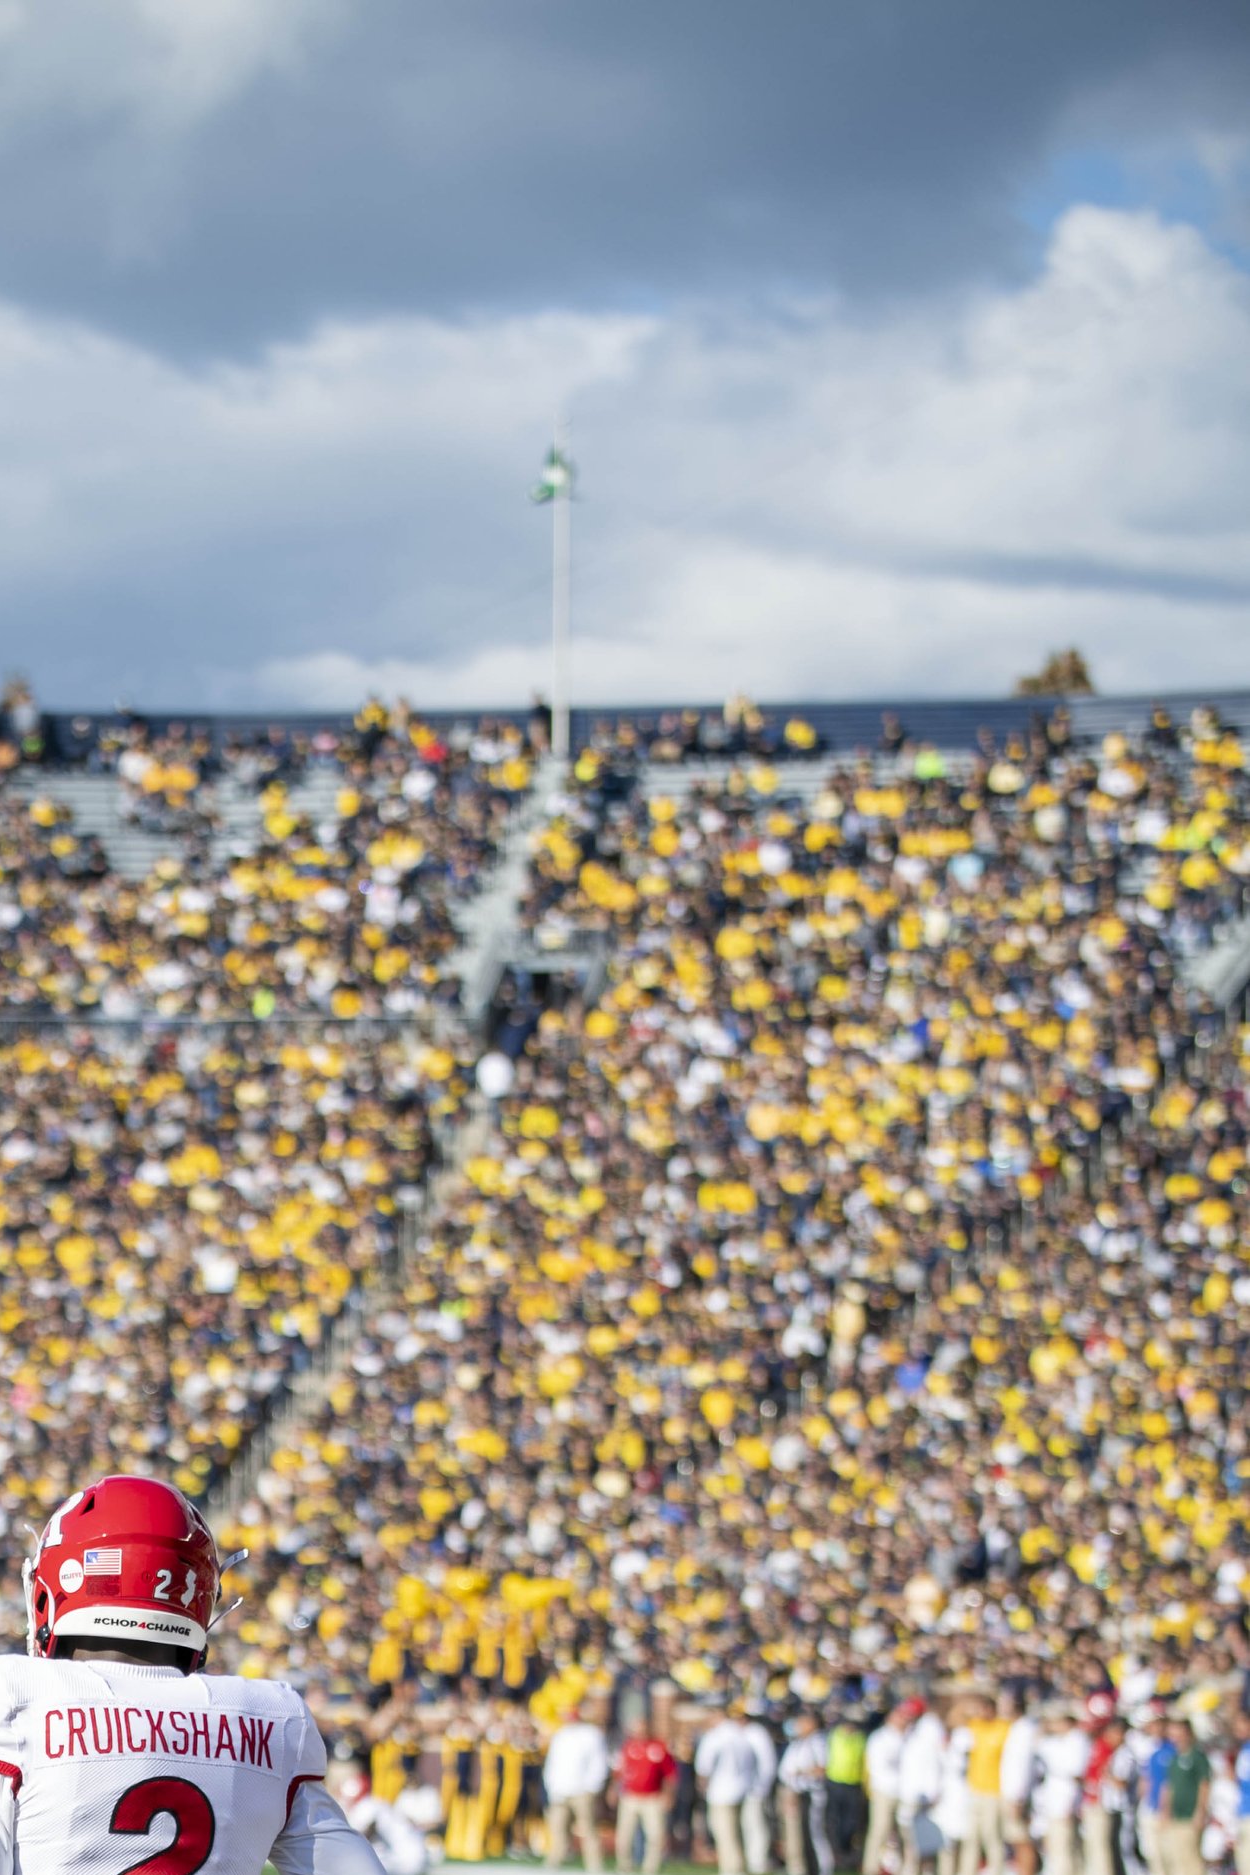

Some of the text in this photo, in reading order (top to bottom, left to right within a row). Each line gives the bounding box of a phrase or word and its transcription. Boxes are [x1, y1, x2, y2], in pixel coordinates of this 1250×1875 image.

[154, 1568, 172, 1600] 2
[93, 1617, 192, 1637] #CHOP4CHANGE
[45, 1707, 275, 1769] CRUICKSHANK
